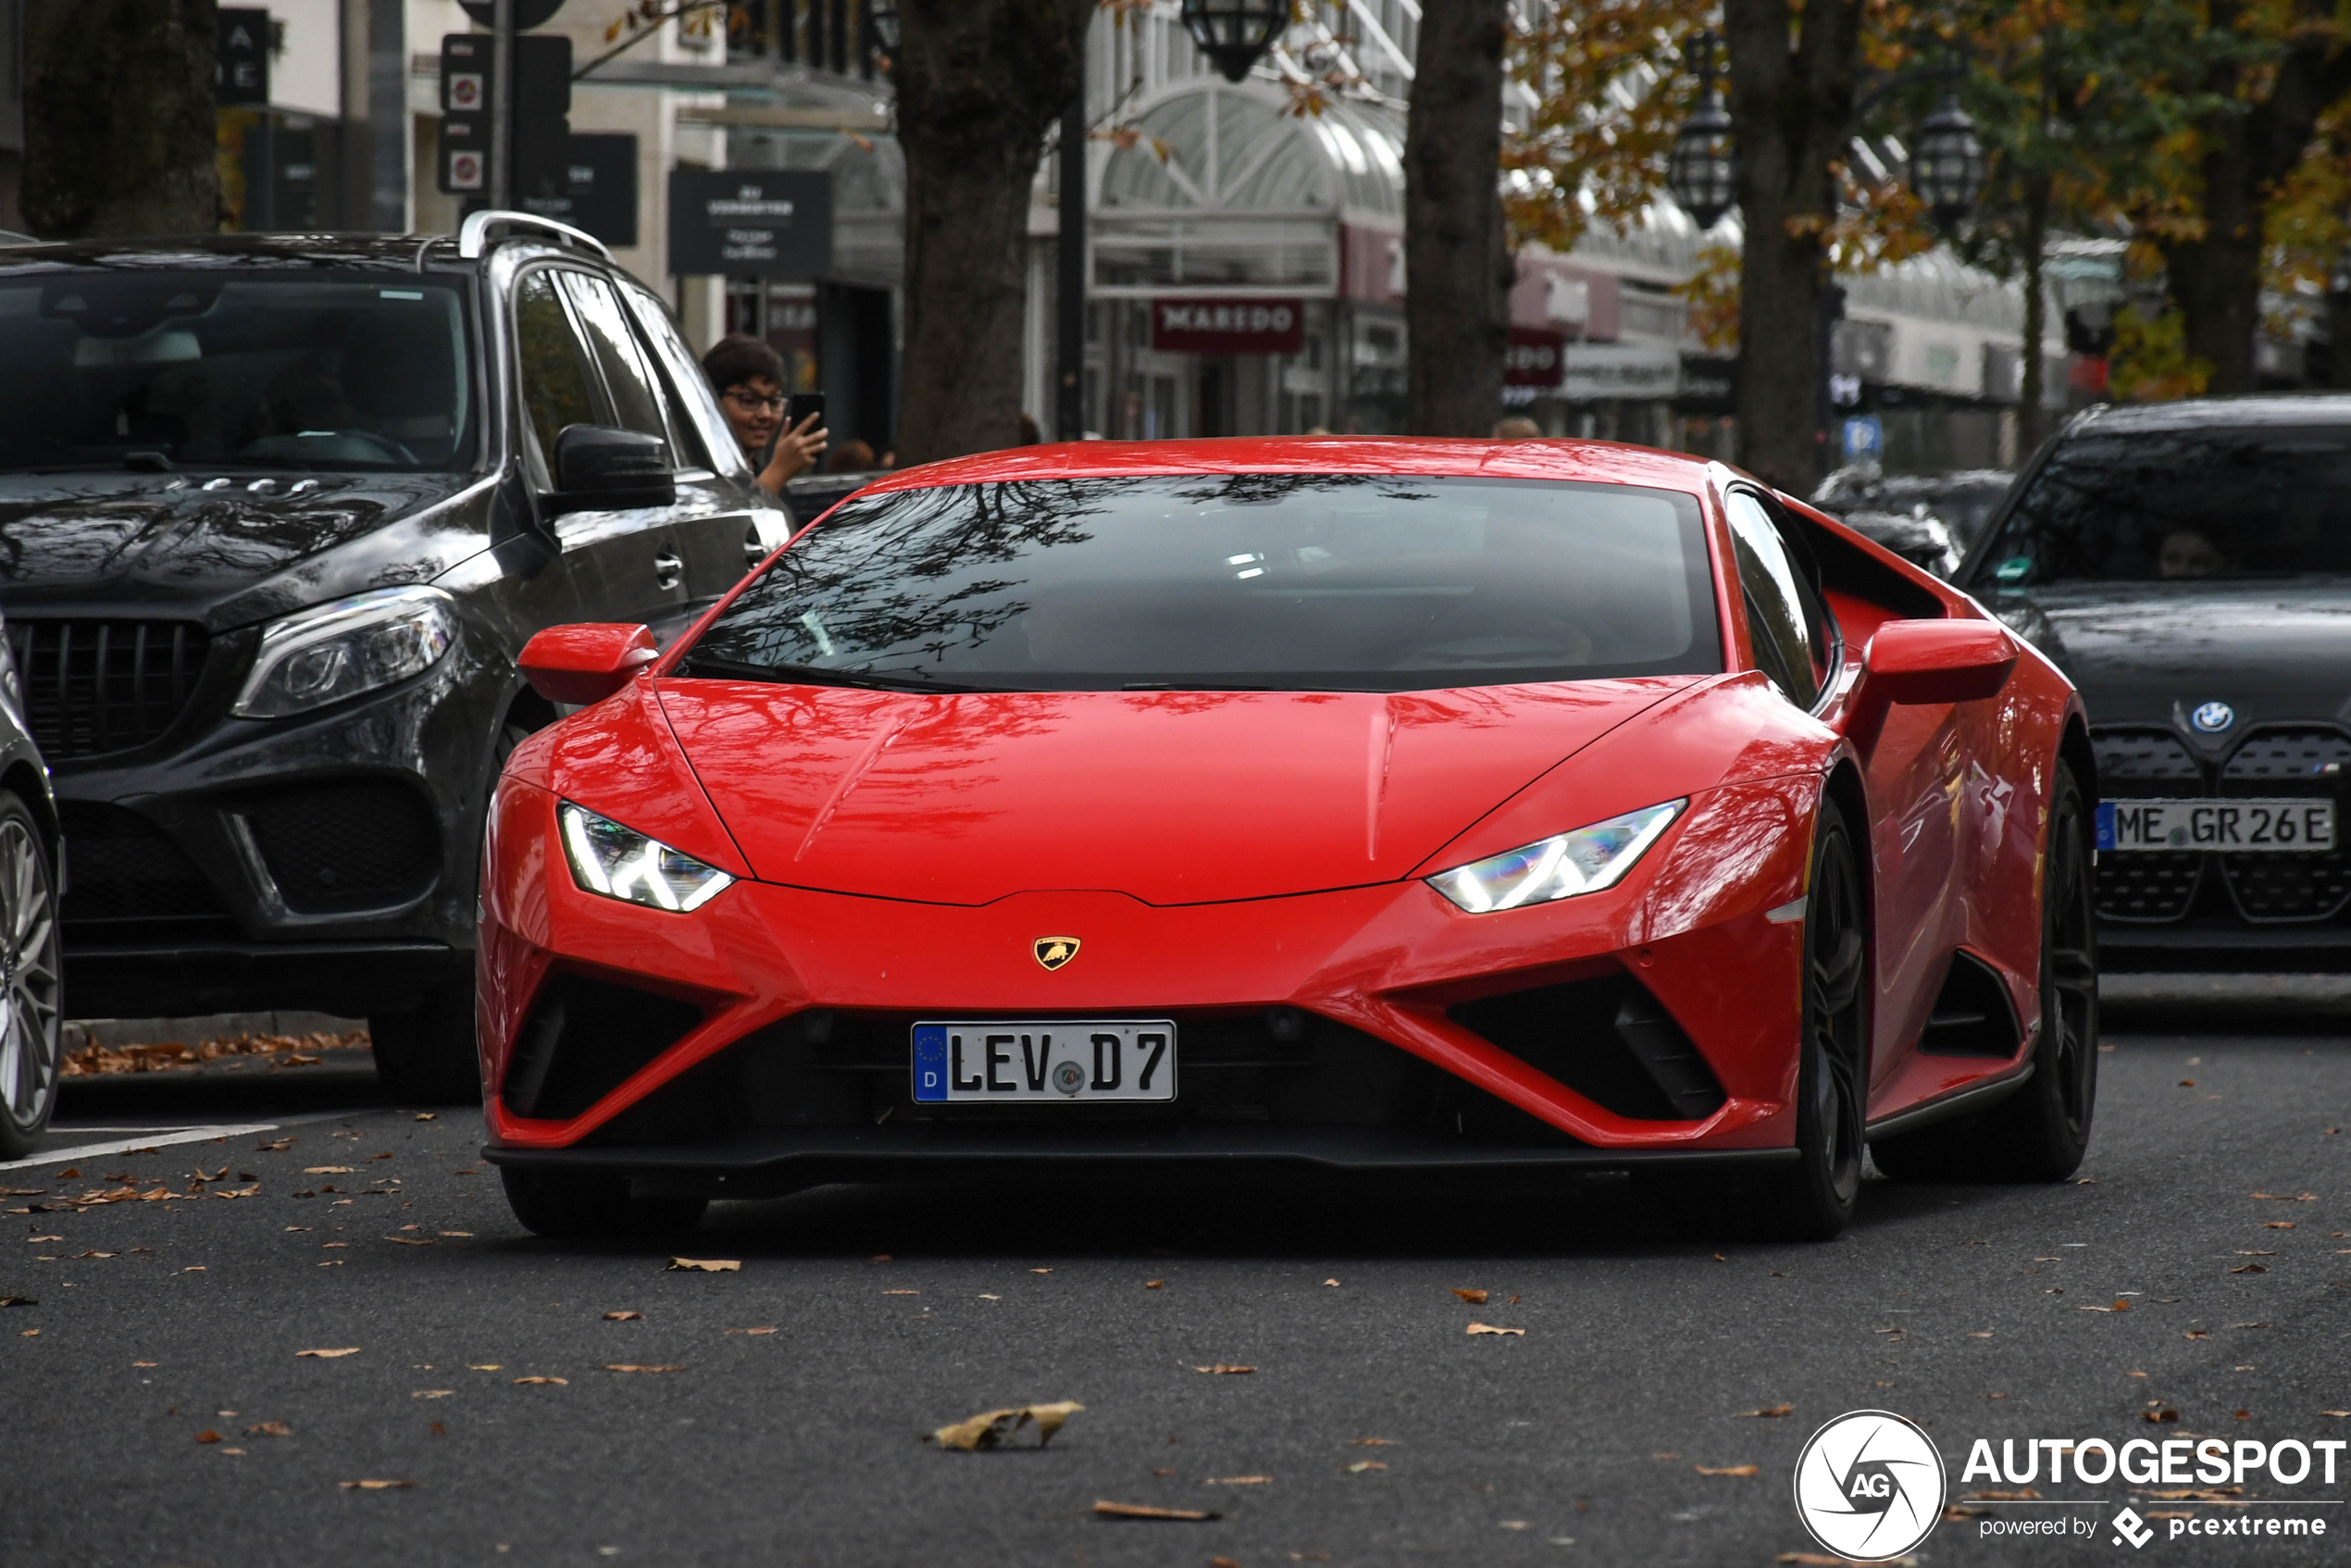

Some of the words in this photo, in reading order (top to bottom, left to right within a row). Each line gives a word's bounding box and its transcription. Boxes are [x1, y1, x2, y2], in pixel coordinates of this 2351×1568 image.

[1163, 306, 1292, 332] MAREDO
[2117, 808, 2166, 843] ME
[952, 1034, 1051, 1091] LEV
[1090, 1033, 1121, 1090] D
[1138, 1033, 1166, 1090] 7
[925, 1072, 937, 1088] D
